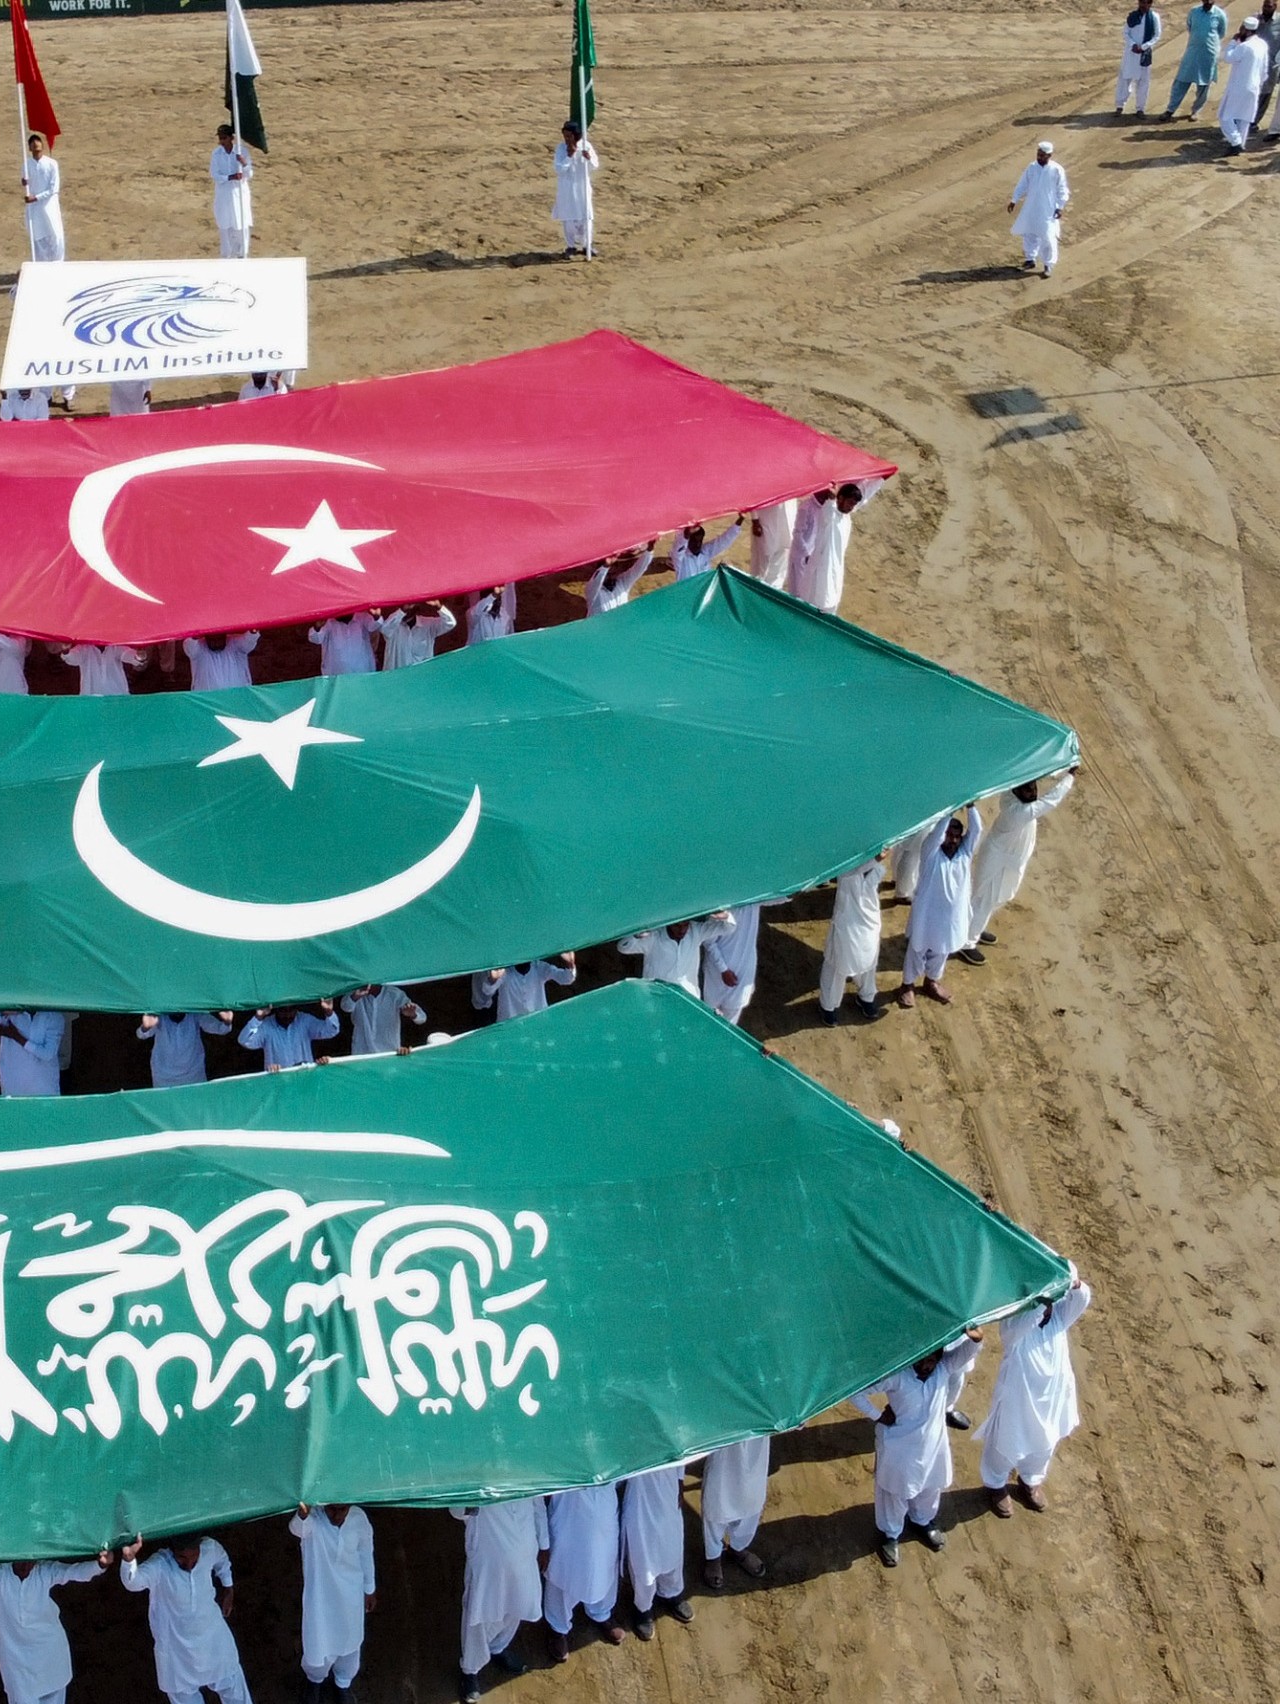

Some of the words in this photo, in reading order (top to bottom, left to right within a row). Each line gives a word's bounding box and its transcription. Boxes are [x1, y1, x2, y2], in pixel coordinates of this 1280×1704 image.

[48, 0, 85, 11] WORK
[89, 0, 112, 9] FOR
[24, 355, 149, 376] MUSLIM
[162, 347, 284, 368] Institute
